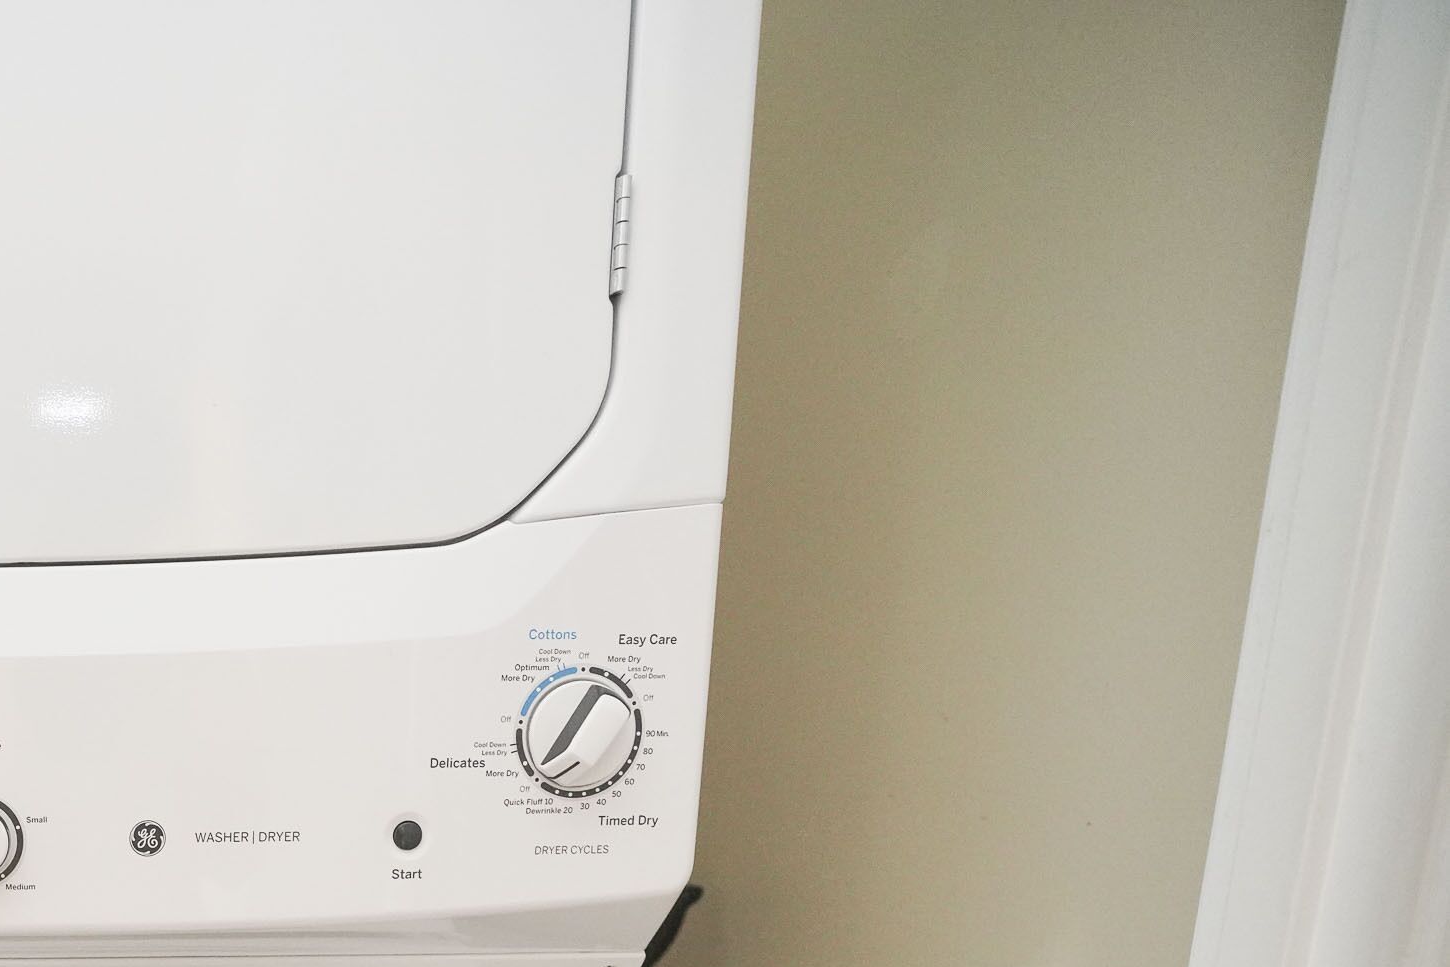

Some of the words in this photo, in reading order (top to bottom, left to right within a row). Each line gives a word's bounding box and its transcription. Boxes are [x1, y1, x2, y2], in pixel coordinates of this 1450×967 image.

[528, 628, 578, 640] Cottons
[618, 634, 646, 647] Easy
[650, 634, 677, 645] Care
[550, 656, 562, 664] Dry
[578, 652, 590, 660] Off
[607, 655, 627, 663] More
[628, 655, 642, 664] Dry
[514, 663, 550, 672] Optimum
[501, 674, 521, 682] More
[522, 674, 536, 683] Dry
[642, 694, 654, 702] Off
[500, 715, 512, 723] Off
[496, 749, 508, 757] Dry
[642, 747, 654, 755] 80
[430, 757, 486, 769] Delicates
[636, 763, 646, 771] 70
[506, 770, 520, 778] Dry
[624, 778, 635, 786] 60
[611, 790, 622, 798] 50
[503, 798, 525, 807] Quick
[526, 798, 543, 806] Fluff
[580, 802, 590, 810] 30
[596, 798, 607, 806] 40
[525, 807, 562, 815] Dewrinkle
[563, 806, 573, 814] 20
[25, 816, 48, 824] Small
[598, 815, 635, 826] Timed
[638, 815, 659, 828] Dry
[194, 831, 250, 843] WASHER
[258, 831, 301, 843] DRYER
[534, 845, 569, 855] DRYER
[570, 844, 610, 854] CYCLES
[391, 868, 422, 880] Start
[5, 883, 36, 891] Medium
